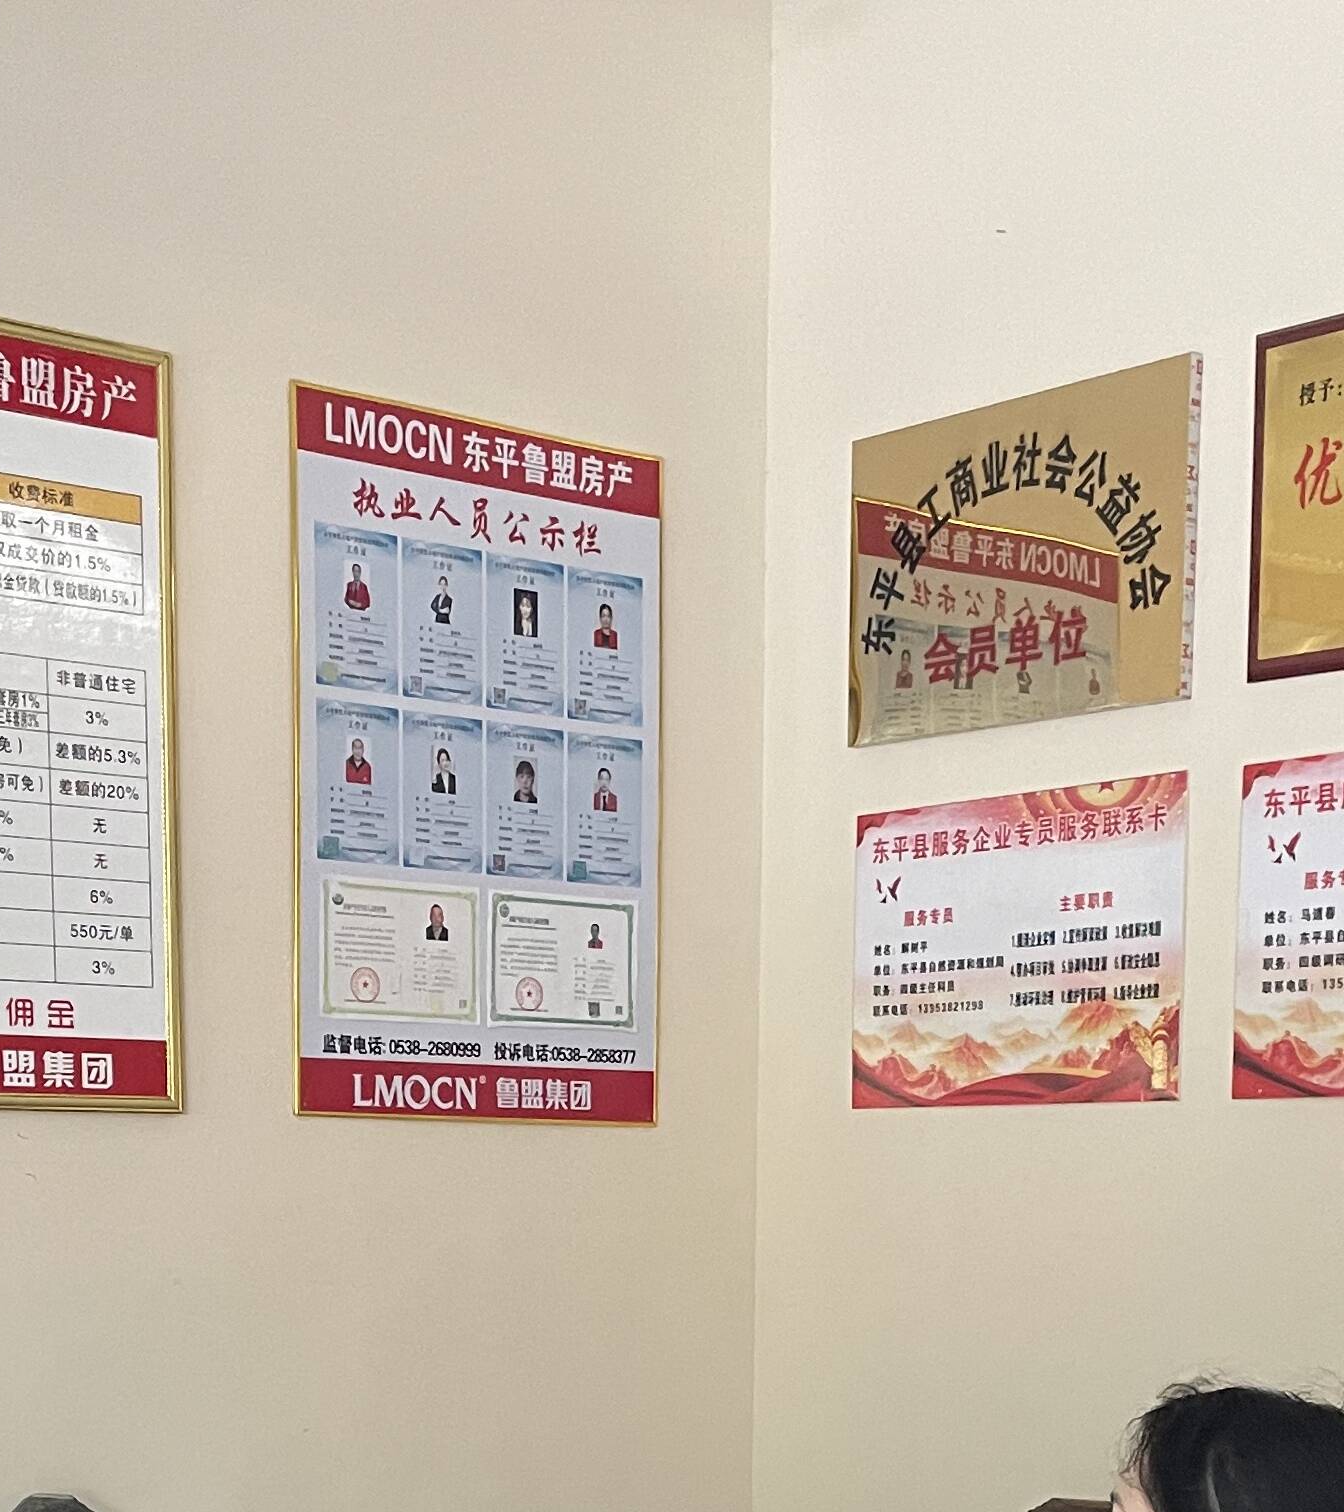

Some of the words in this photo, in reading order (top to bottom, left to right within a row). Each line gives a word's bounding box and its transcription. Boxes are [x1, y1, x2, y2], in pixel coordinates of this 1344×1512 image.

[324, 401, 453, 465] LMOCN
[463, 431, 632, 498] 东平鲁盟房产
[9, 481, 75, 506] 收费标准
[353, 478, 602, 557] 执业人员公示栏
[861, 432, 1172, 656] 东平县工商业社会公益协会
[924, 606, 1088, 684] 会员单位
[57, 670, 136, 694] 非普通住宅
[85, 711, 109, 726] 3%
[55, 742, 141, 767] 差额的5.3%
[58, 780, 140, 802] 差额的20%
[92, 818, 107, 835] 无
[872, 803, 1167, 864] 东平县服务企业专员服务联系卡
[94, 853, 108, 869] 无
[89, 889, 113, 905] 6%
[1059, 892, 1113, 913] 主要职责
[904, 907, 953, 926] 服务专员
[70, 924, 134, 941] 550元/单
[92, 960, 115, 976] 3%
[353, 1073, 478, 1110] LMOCN
[496, 1077, 592, 1111] 鲁盟集团
